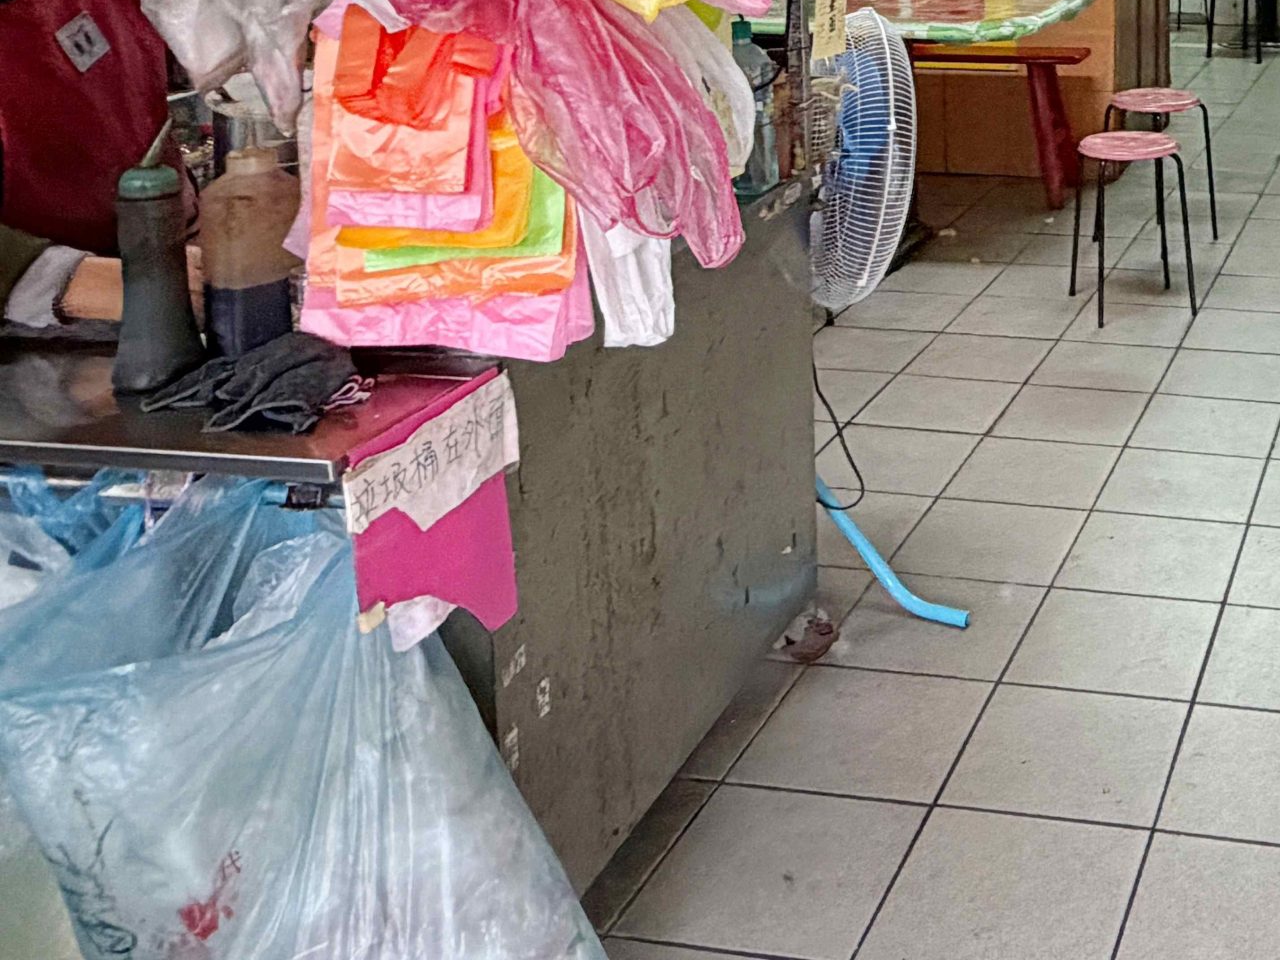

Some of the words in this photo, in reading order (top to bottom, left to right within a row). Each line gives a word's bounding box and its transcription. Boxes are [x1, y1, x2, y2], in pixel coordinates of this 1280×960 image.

[350, 398, 505, 522] 垃圾桶在外面
